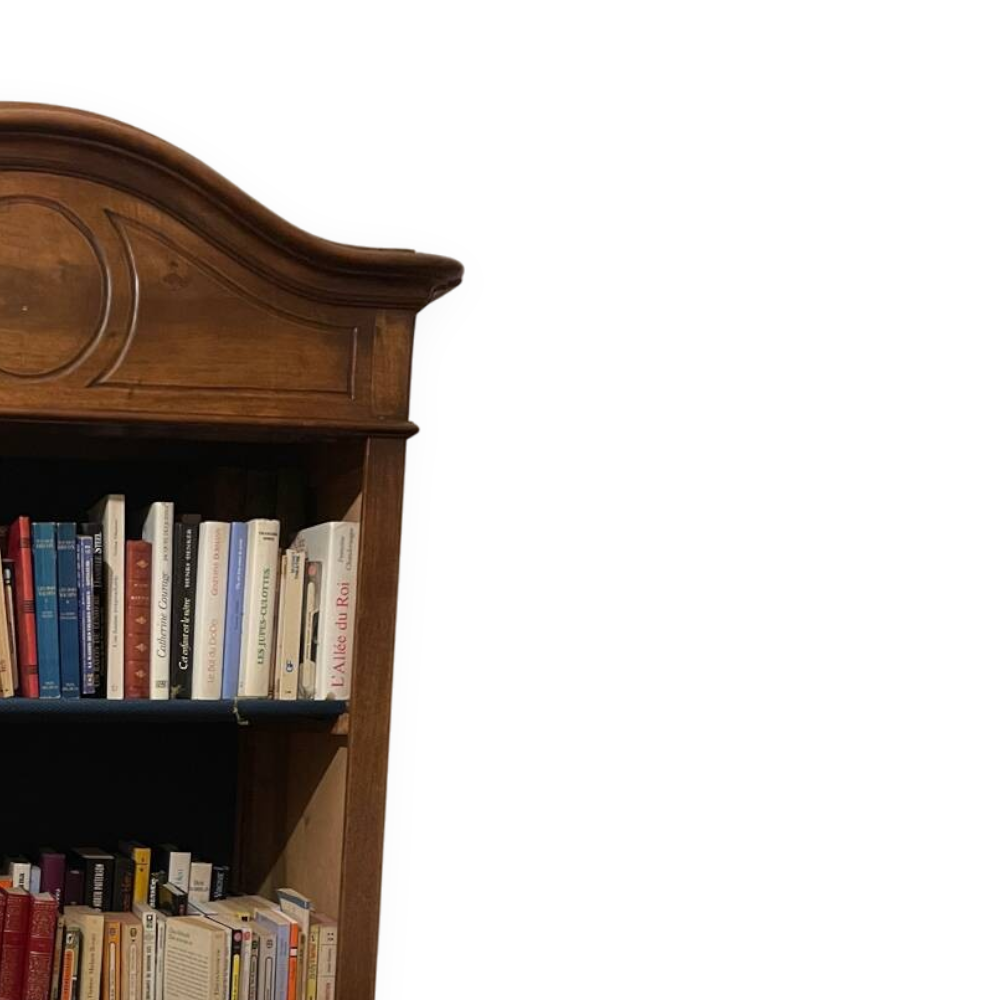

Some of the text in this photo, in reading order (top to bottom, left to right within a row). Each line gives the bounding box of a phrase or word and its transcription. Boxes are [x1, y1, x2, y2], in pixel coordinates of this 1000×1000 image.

[156, 570, 169, 658] Catherine Courage
[331, 581, 349, 687] L'Allée du Roi
